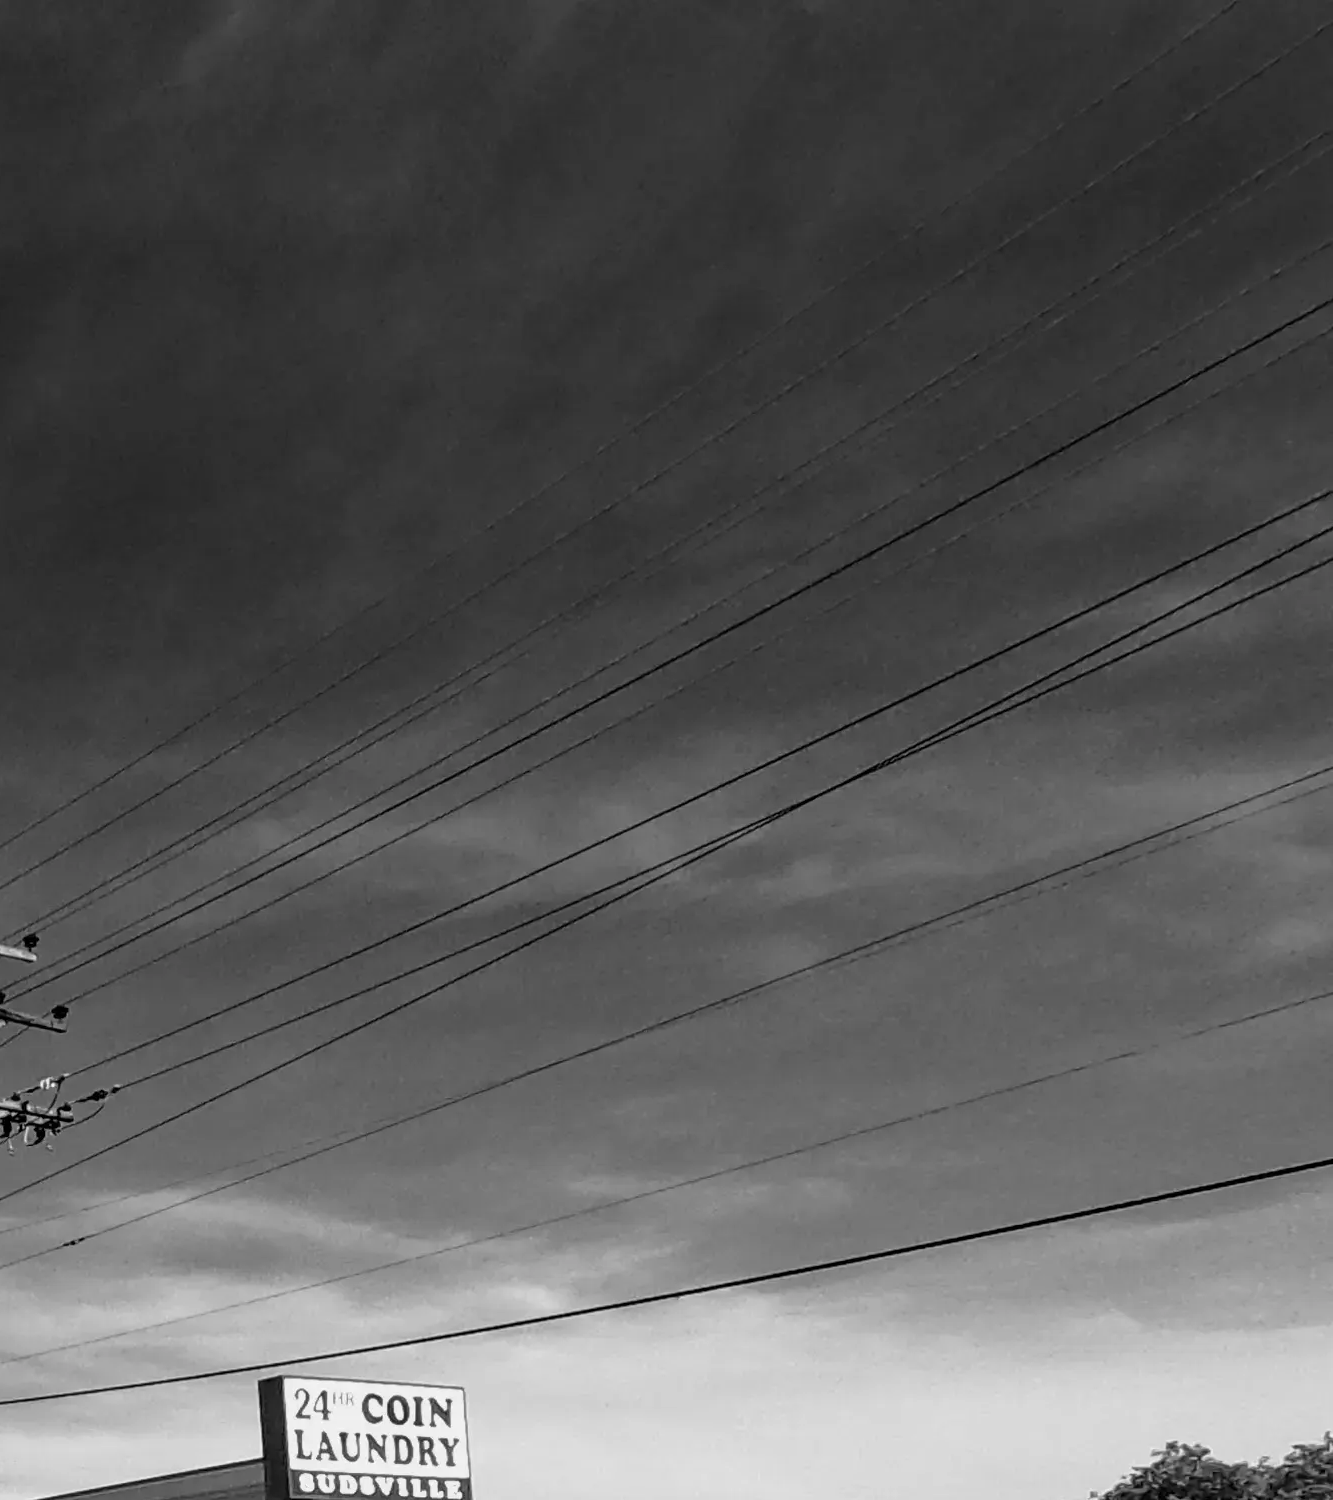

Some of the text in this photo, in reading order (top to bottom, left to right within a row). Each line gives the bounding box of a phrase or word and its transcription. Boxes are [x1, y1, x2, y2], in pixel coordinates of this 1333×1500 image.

[361, 1392, 453, 1428] COIN
[294, 1429, 460, 1467] LAUNDRY
[298, 1472, 463, 1500] SUDSVILLE
